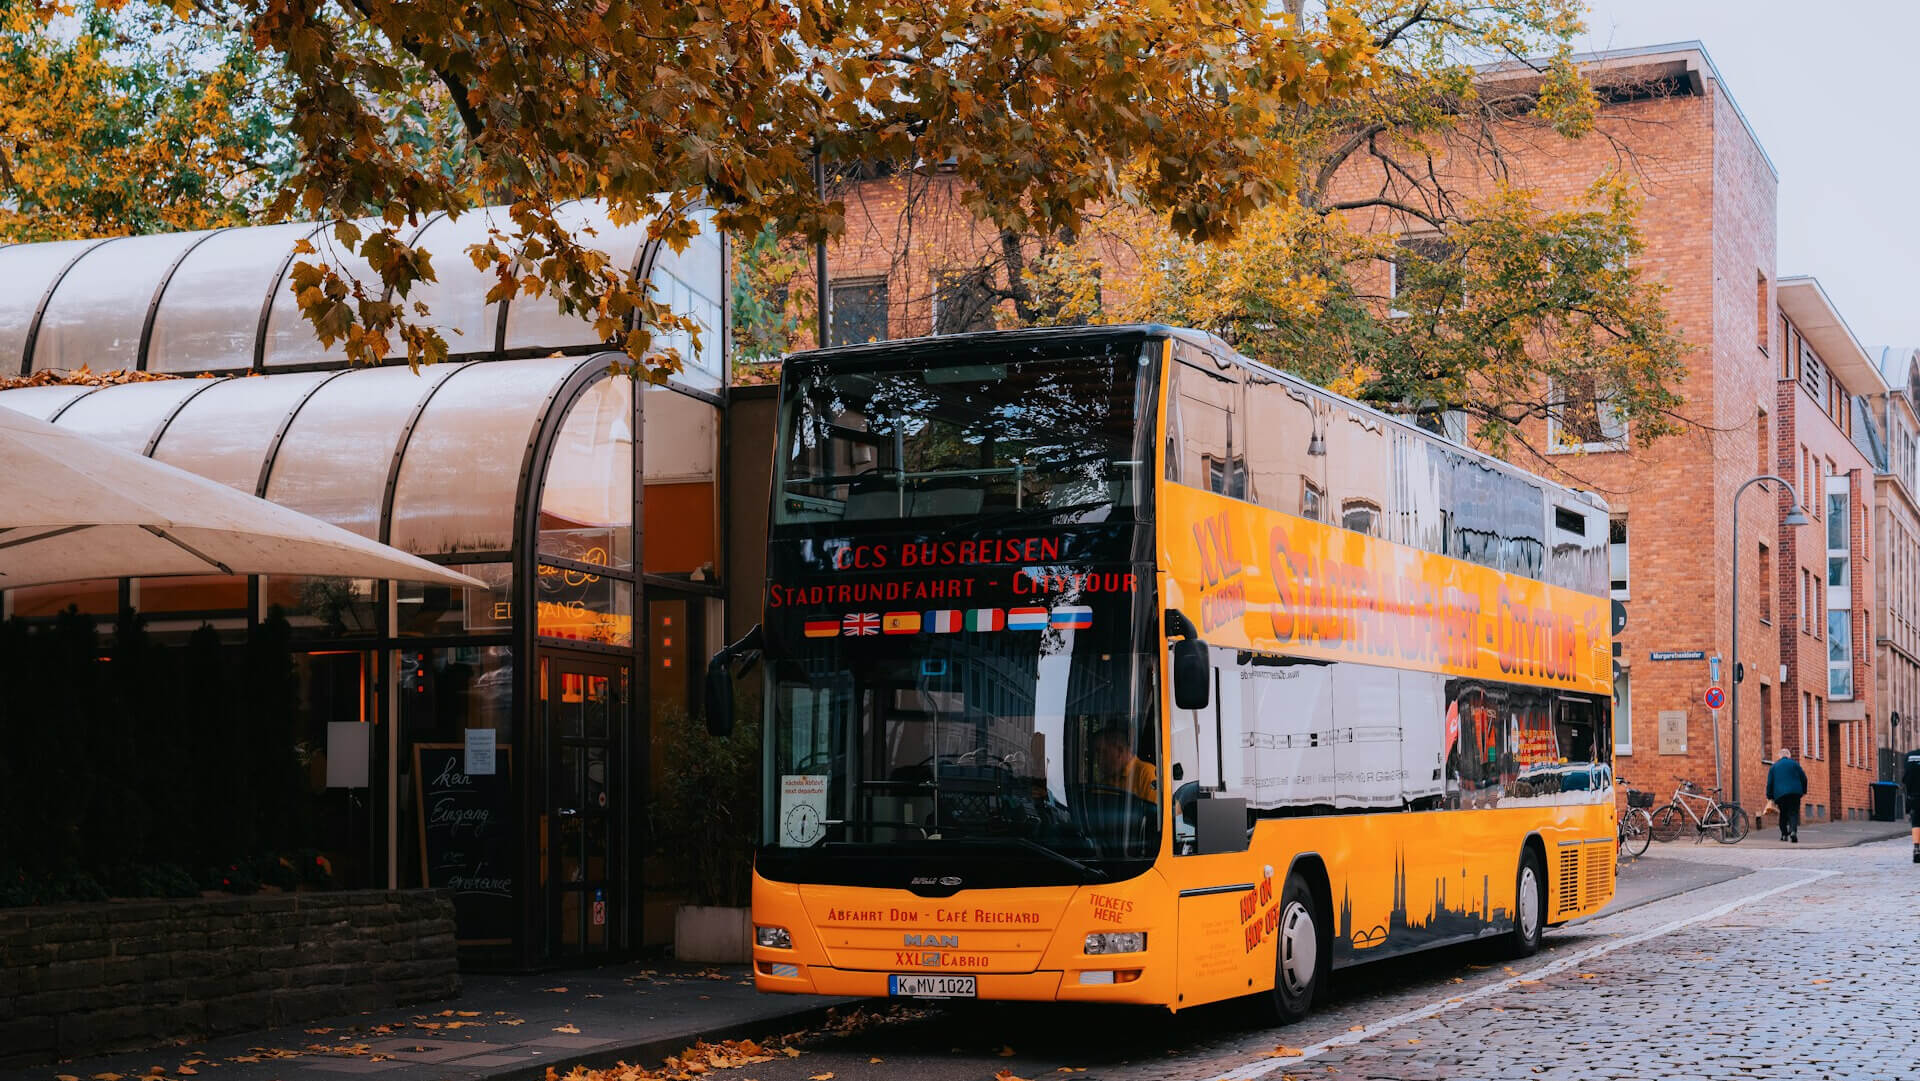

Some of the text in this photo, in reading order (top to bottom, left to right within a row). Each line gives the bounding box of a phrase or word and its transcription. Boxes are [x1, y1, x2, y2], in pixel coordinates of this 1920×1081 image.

[838, 536, 1059, 570] CCS BUSREISEN
[1192, 510, 1241, 591] XXL
[1090, 893, 1134, 913] TICKETS
[1240, 876, 1272, 925] HOP ON
[1094, 907, 1123, 924] HERE
[904, 934, 958, 948] MAN
[1245, 918, 1263, 954] HOP
[896, 951, 922, 966] XXL
[899, 978, 974, 994] K MV 1022
